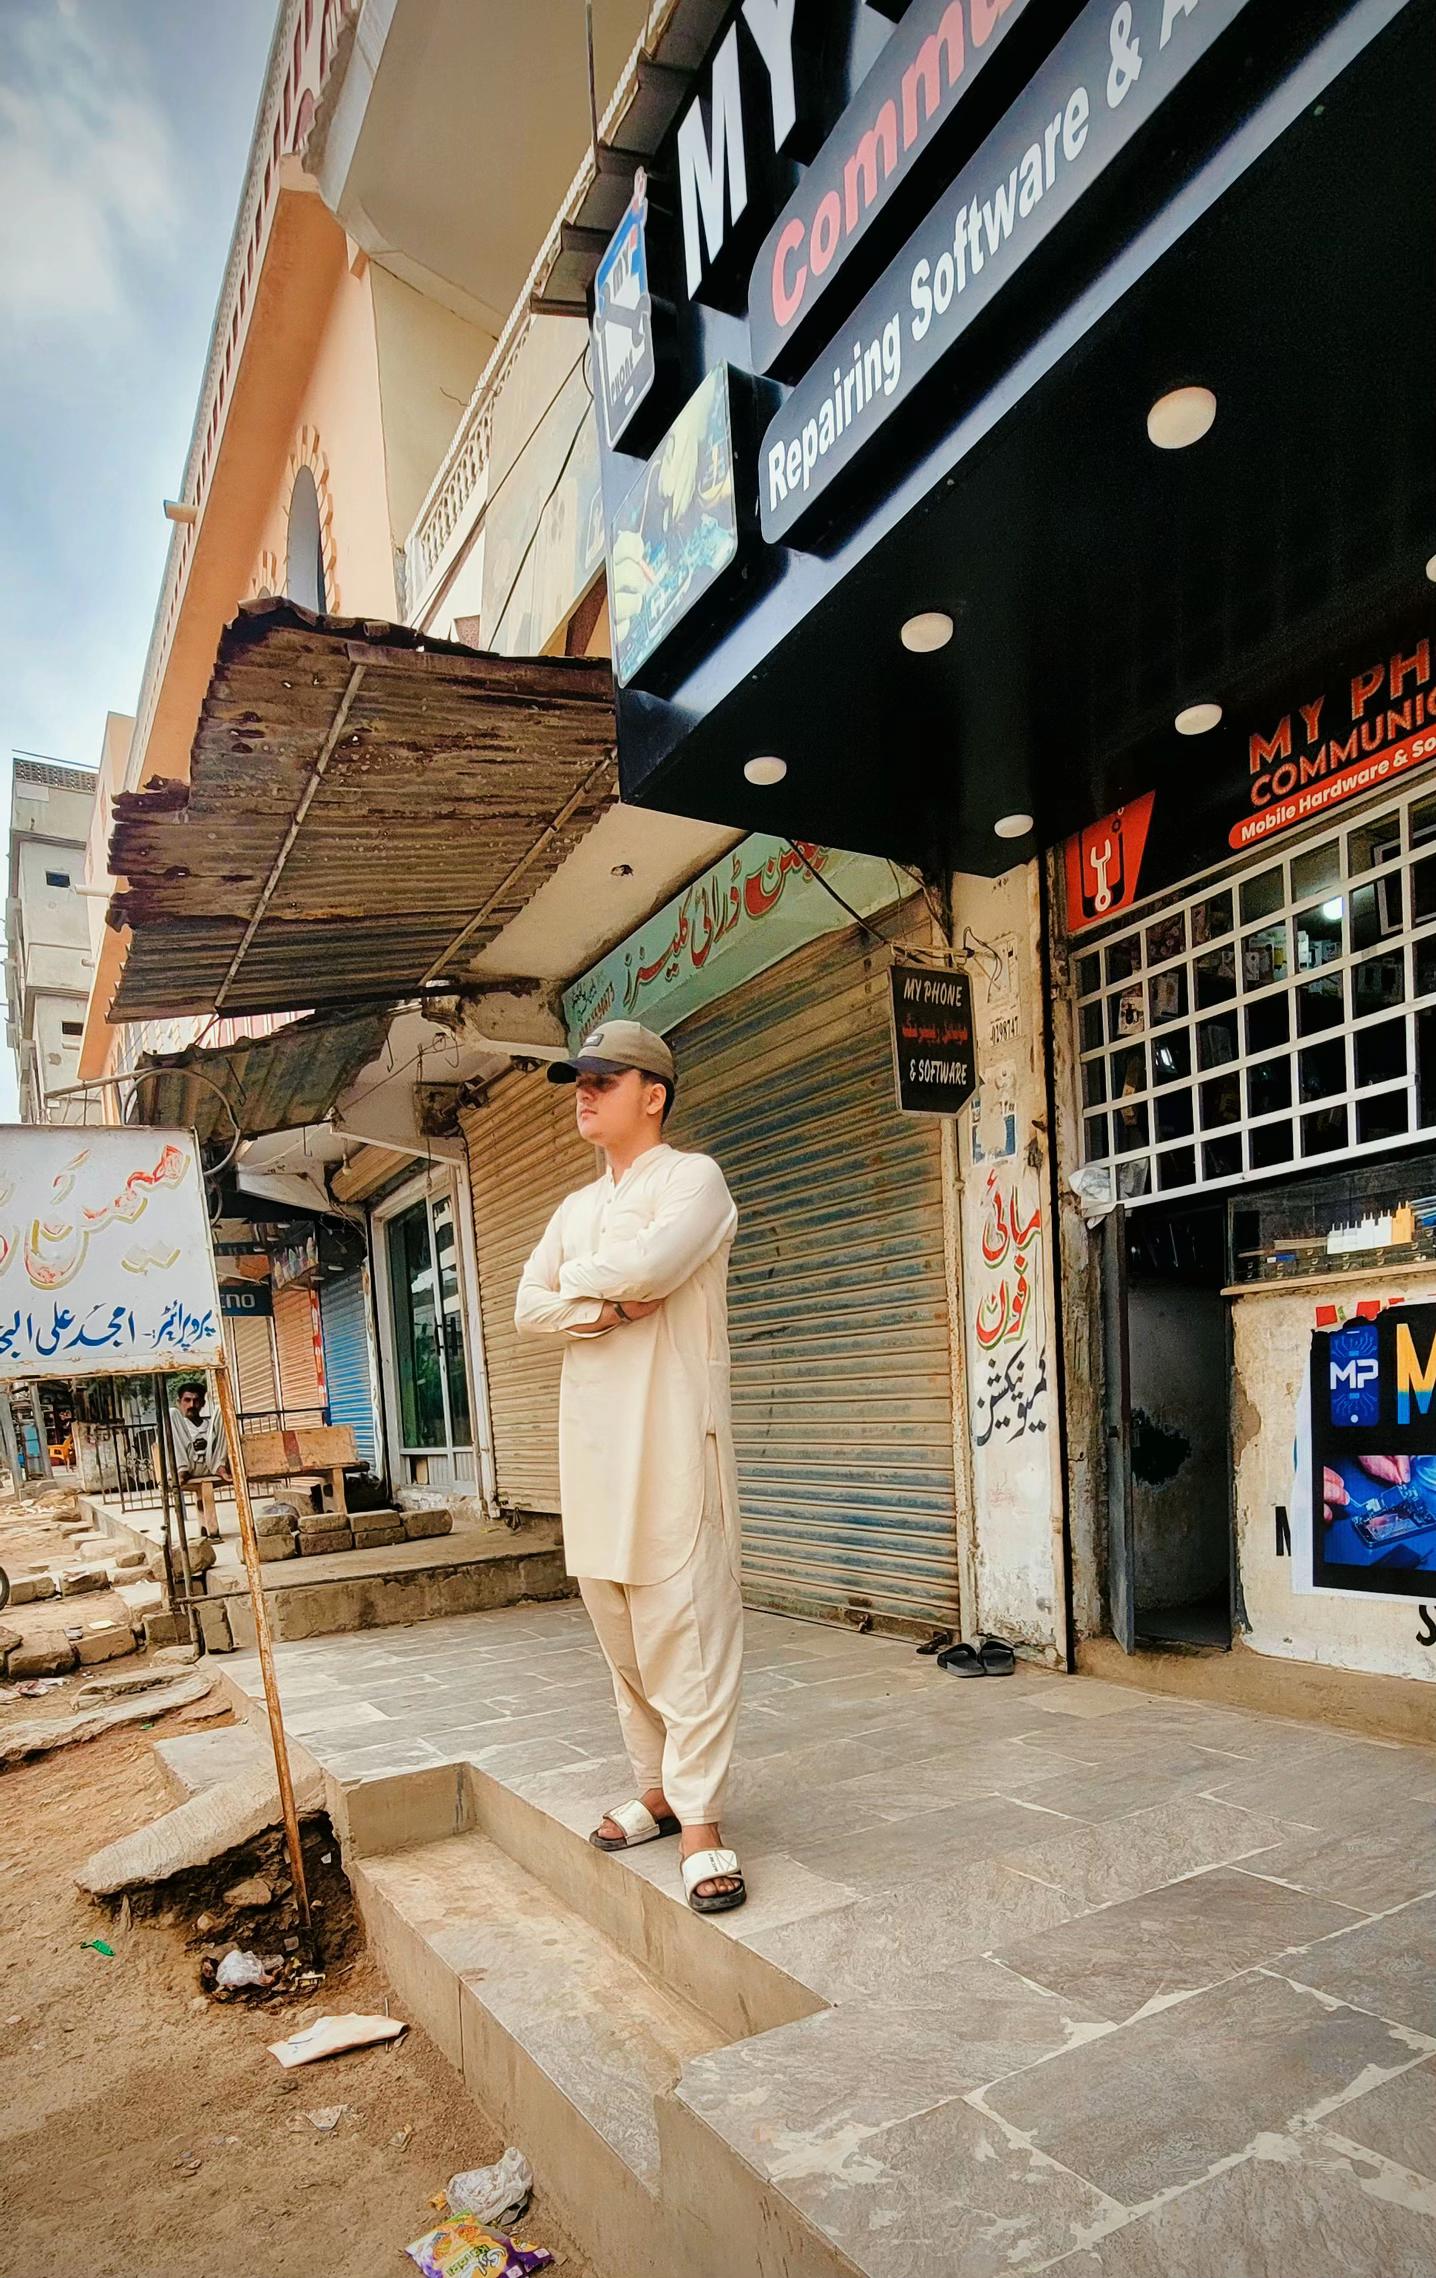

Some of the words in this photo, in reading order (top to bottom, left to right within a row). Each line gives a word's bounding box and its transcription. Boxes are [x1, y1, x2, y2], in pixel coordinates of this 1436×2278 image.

[677, 0, 797, 301] MY
[768, 312, 901, 513] Repairing
[910, 86, 1089, 342] Software
[1106, 1, 1143, 109] &
[1249, 694, 1326, 774] MY
[1240, 803, 1296, 842] Mobile
[1298, 755, 1390, 813] Hardware
[1393, 748, 1409, 768] &
[903, 977, 922, 1001] MY
[923, 979, 963, 1008] PHONE
[909, 1058, 917, 1084] &
[918, 1058, 968, 1086] SOFTWARE
[36, 1300, 76, 1356] علی
[975, 1253, 1029, 1345] فون
[1329, 1357, 1379, 1390] MP
